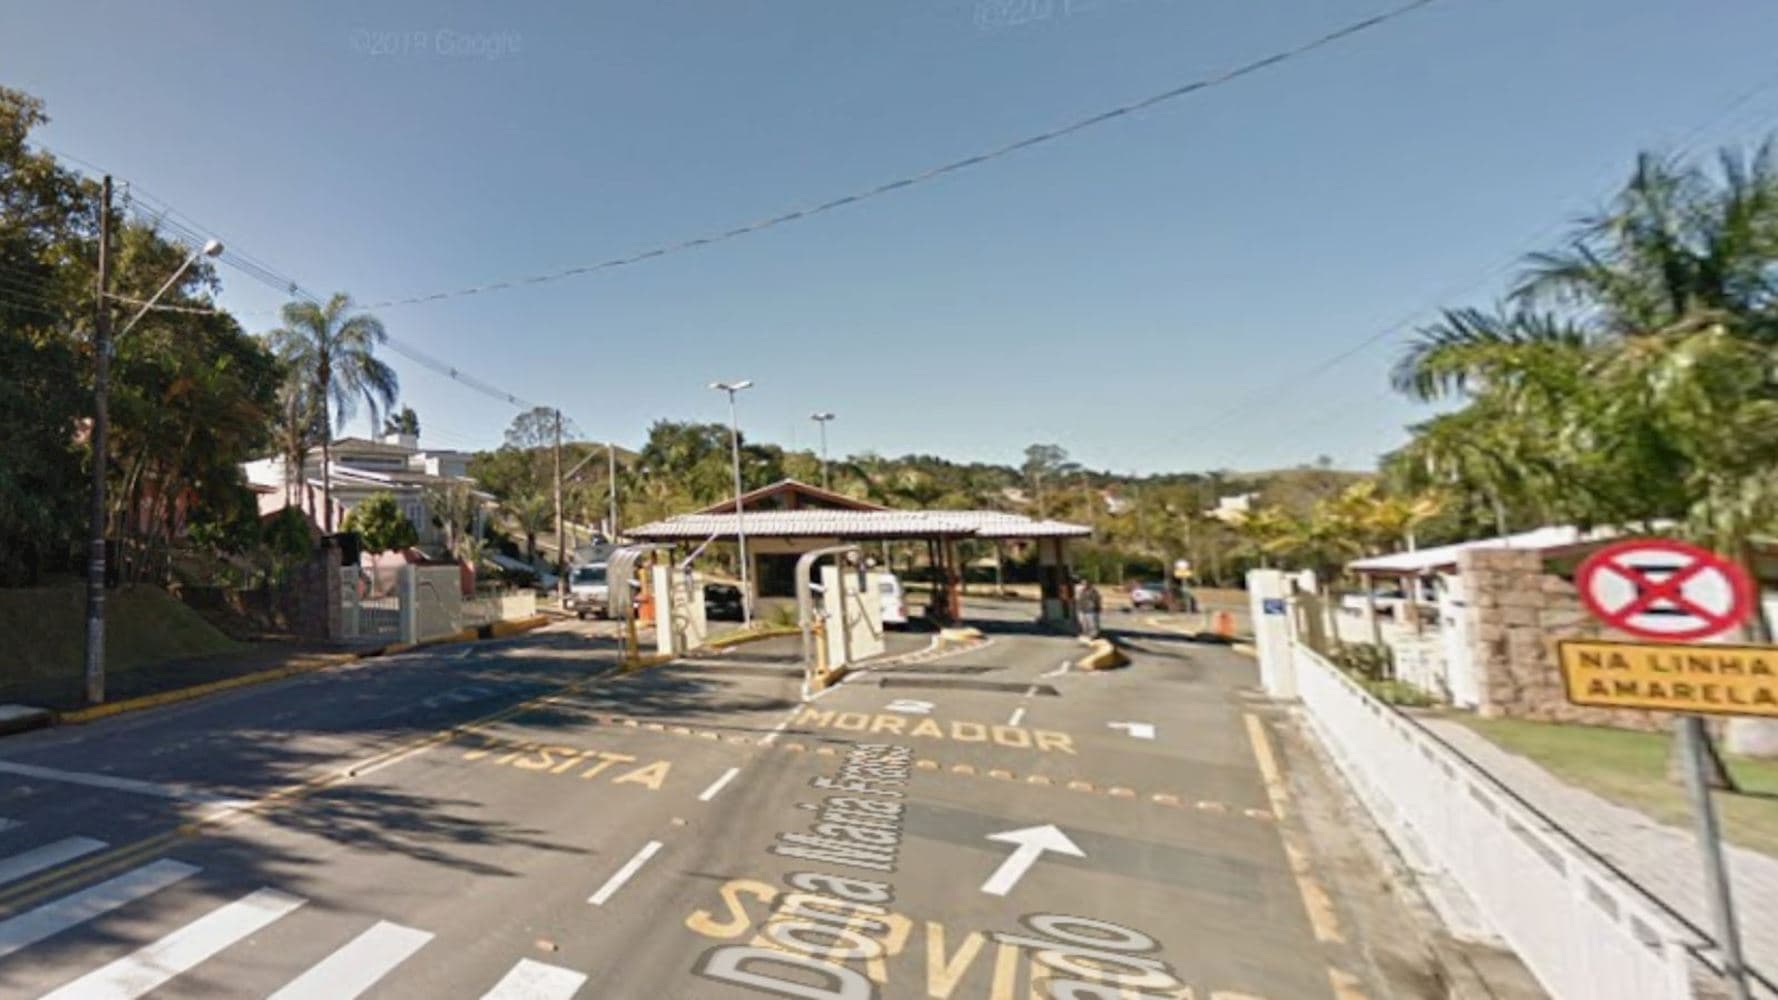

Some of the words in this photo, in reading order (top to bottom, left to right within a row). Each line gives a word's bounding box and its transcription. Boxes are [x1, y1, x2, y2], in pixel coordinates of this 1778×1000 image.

[1580, 651, 1630, 670] NA
[1647, 654, 1776, 676] LINHA
[1588, 678, 1778, 705] AMARELA
[795, 706, 1077, 755] MORADOR
